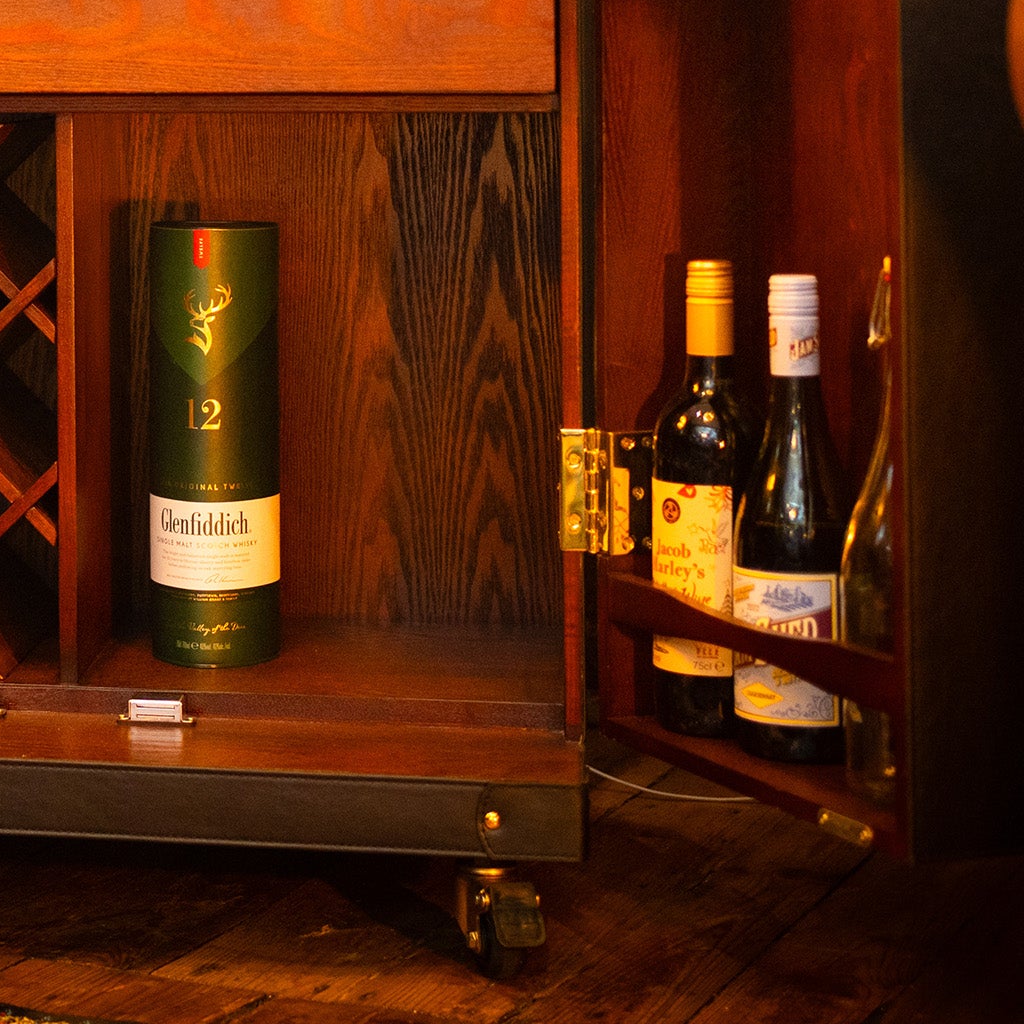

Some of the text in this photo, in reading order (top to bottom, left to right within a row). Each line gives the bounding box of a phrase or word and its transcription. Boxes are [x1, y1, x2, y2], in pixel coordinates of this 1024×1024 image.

[188, 398, 222, 430] 12
[161, 507, 249, 537] Glenfiddich
[176, 539, 193, 549] MALT
[196, 541, 230, 549] SCOTCH
[232, 539, 257, 548] WHISKY
[657, 538, 691, 559] Jacob
